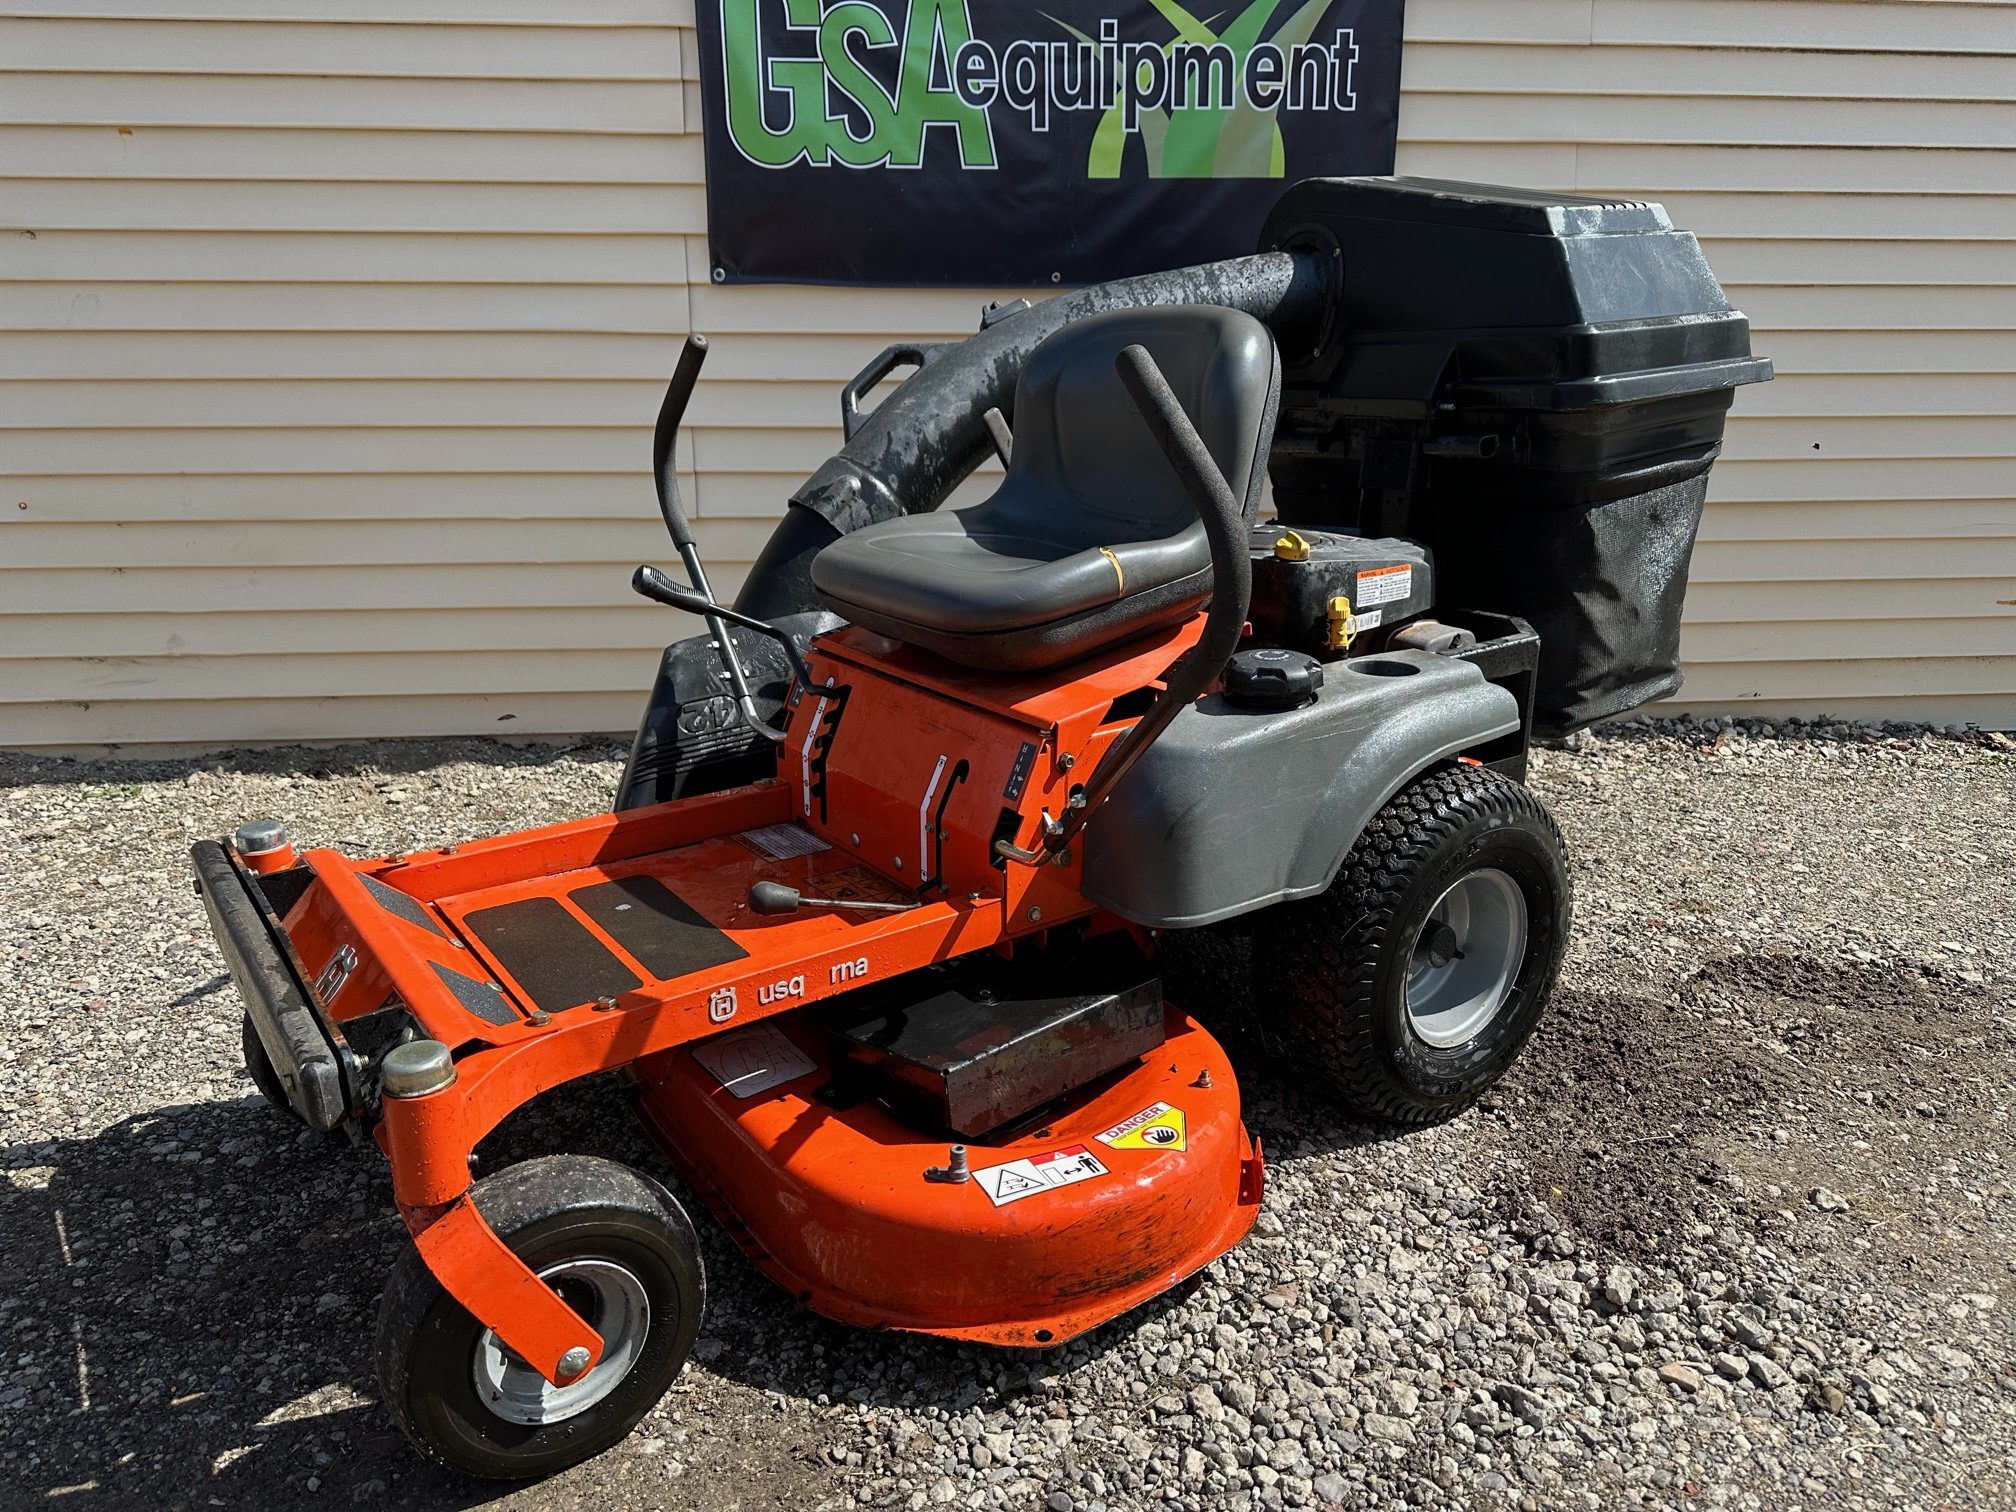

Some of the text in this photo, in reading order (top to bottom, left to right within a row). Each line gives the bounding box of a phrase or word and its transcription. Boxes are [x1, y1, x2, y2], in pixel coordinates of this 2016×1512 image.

[719, 0, 1358, 169] GSA equipment
[1105, 1106, 1164, 1139] DANGER
